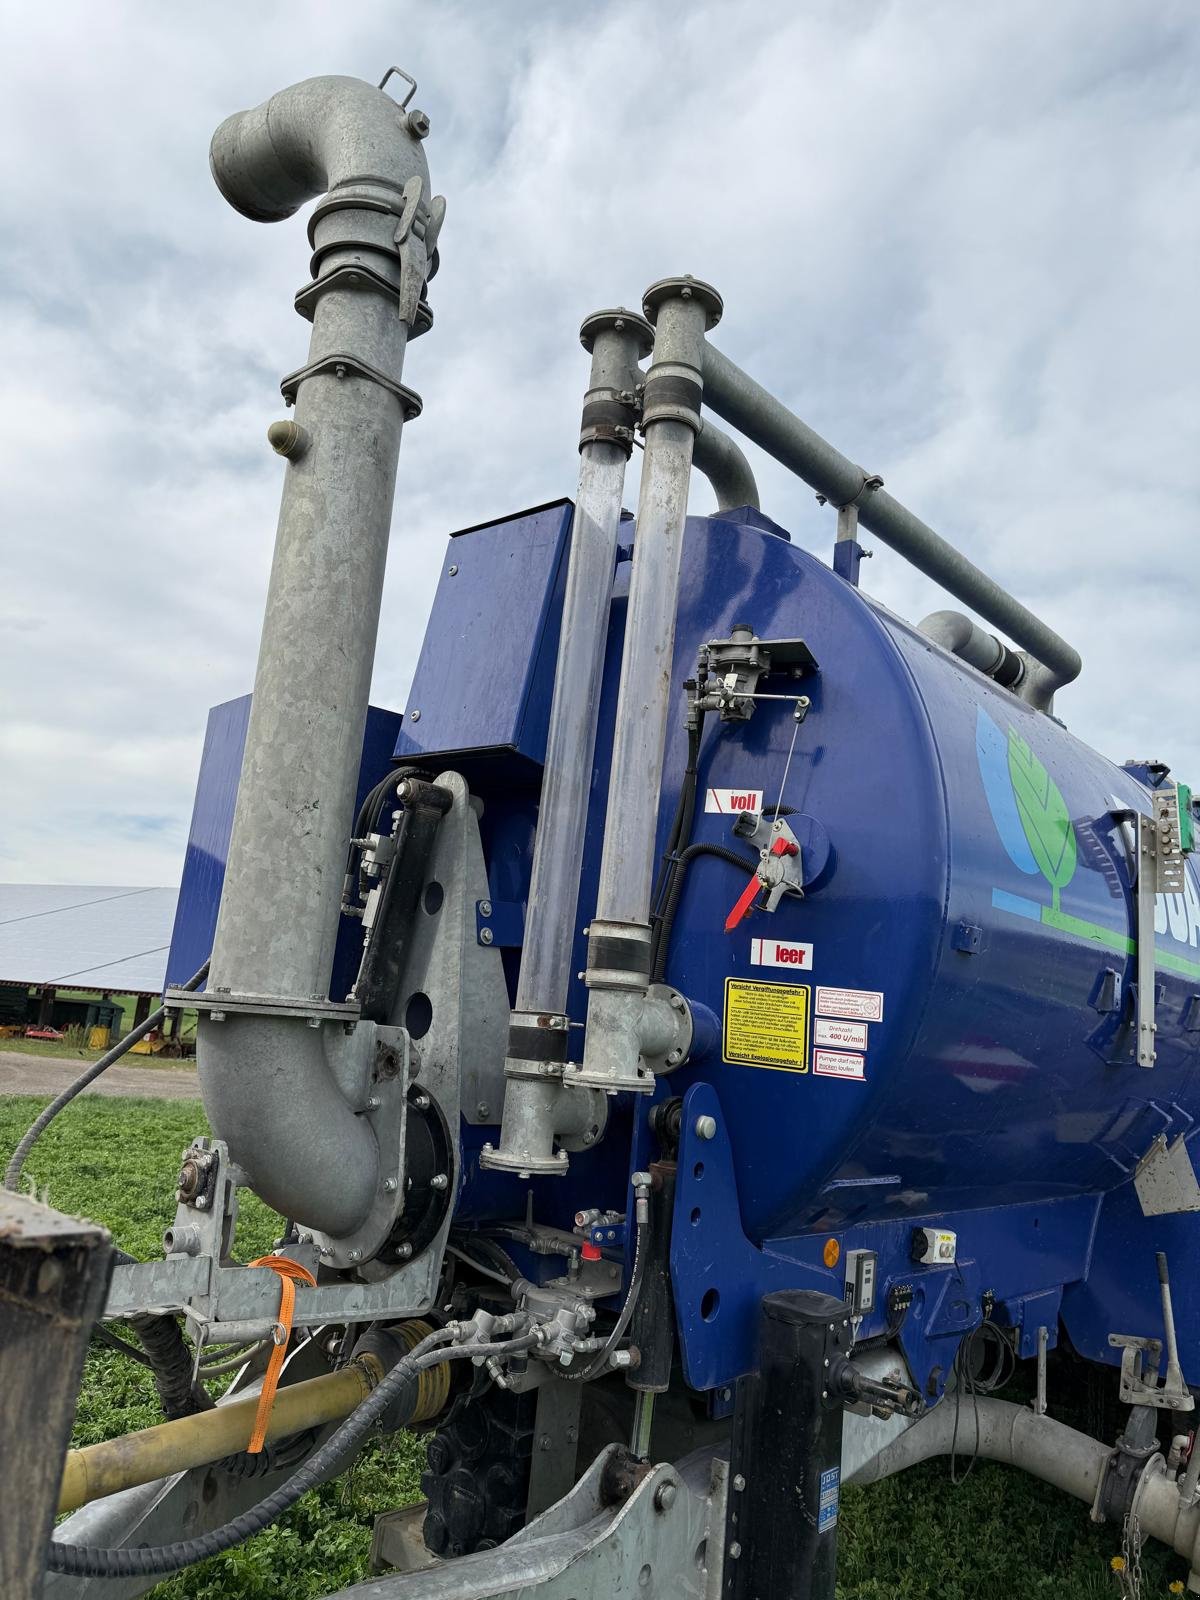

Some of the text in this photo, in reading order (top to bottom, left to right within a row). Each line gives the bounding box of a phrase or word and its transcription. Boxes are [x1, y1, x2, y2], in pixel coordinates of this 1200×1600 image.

[730, 793, 757, 811] voll
[775, 944, 806, 965] leer
[843, 1035, 864, 1043] U/min
